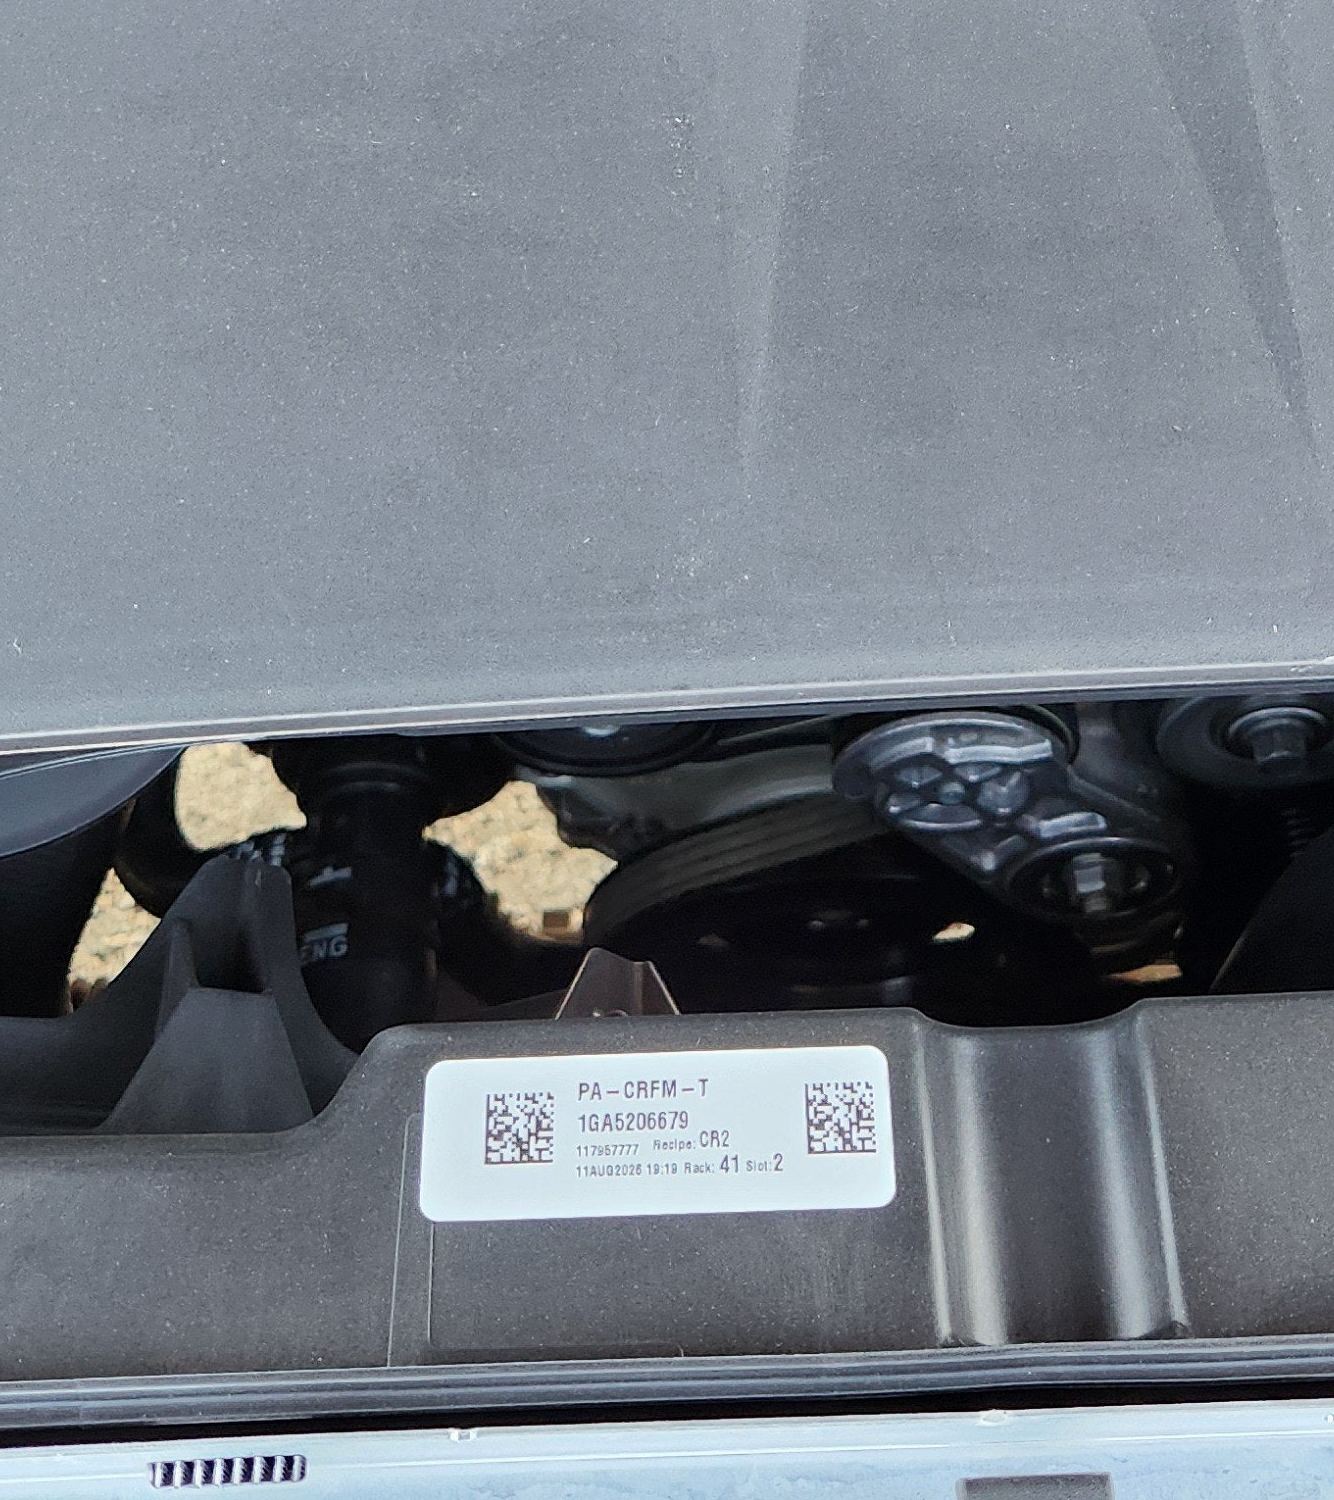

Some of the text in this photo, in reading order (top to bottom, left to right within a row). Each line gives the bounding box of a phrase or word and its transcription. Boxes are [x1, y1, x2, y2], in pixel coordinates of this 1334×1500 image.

[578, 1111, 690, 1133] 1GA5206679
[652, 1138, 696, 1152] Recipe:
[700, 1130, 731, 1149] CR2
[684, 1160, 715, 1175] Rack:
[720, 1154, 739, 1174] 41
